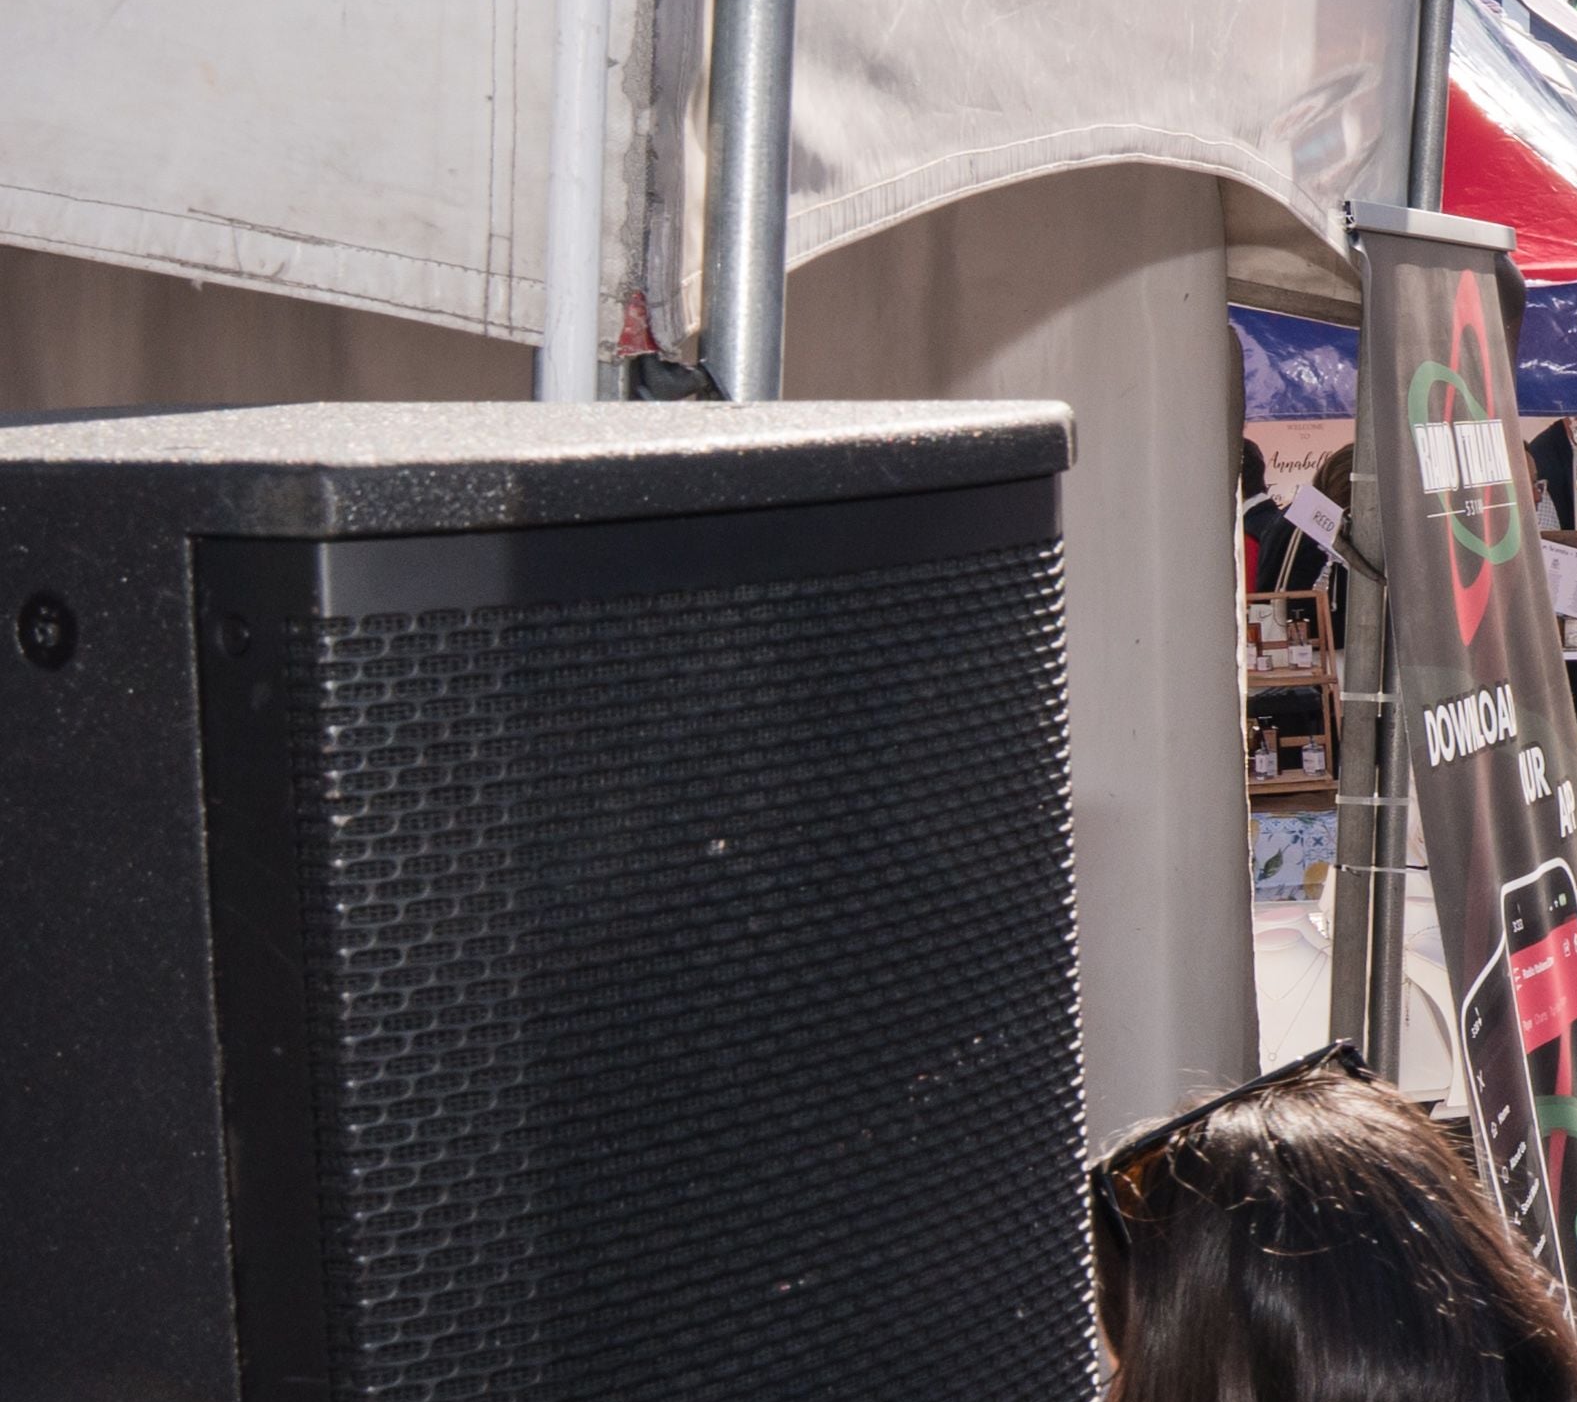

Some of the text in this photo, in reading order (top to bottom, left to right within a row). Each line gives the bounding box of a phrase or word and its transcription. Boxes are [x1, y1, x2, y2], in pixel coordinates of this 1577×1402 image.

[1287, 423, 1323, 431] WELCOME
[1268, 450, 1330, 473] Annabell
[1311, 509, 1335, 533] REED
[1518, 746, 1552, 806] UR
[1557, 780, 1577, 838] AP
